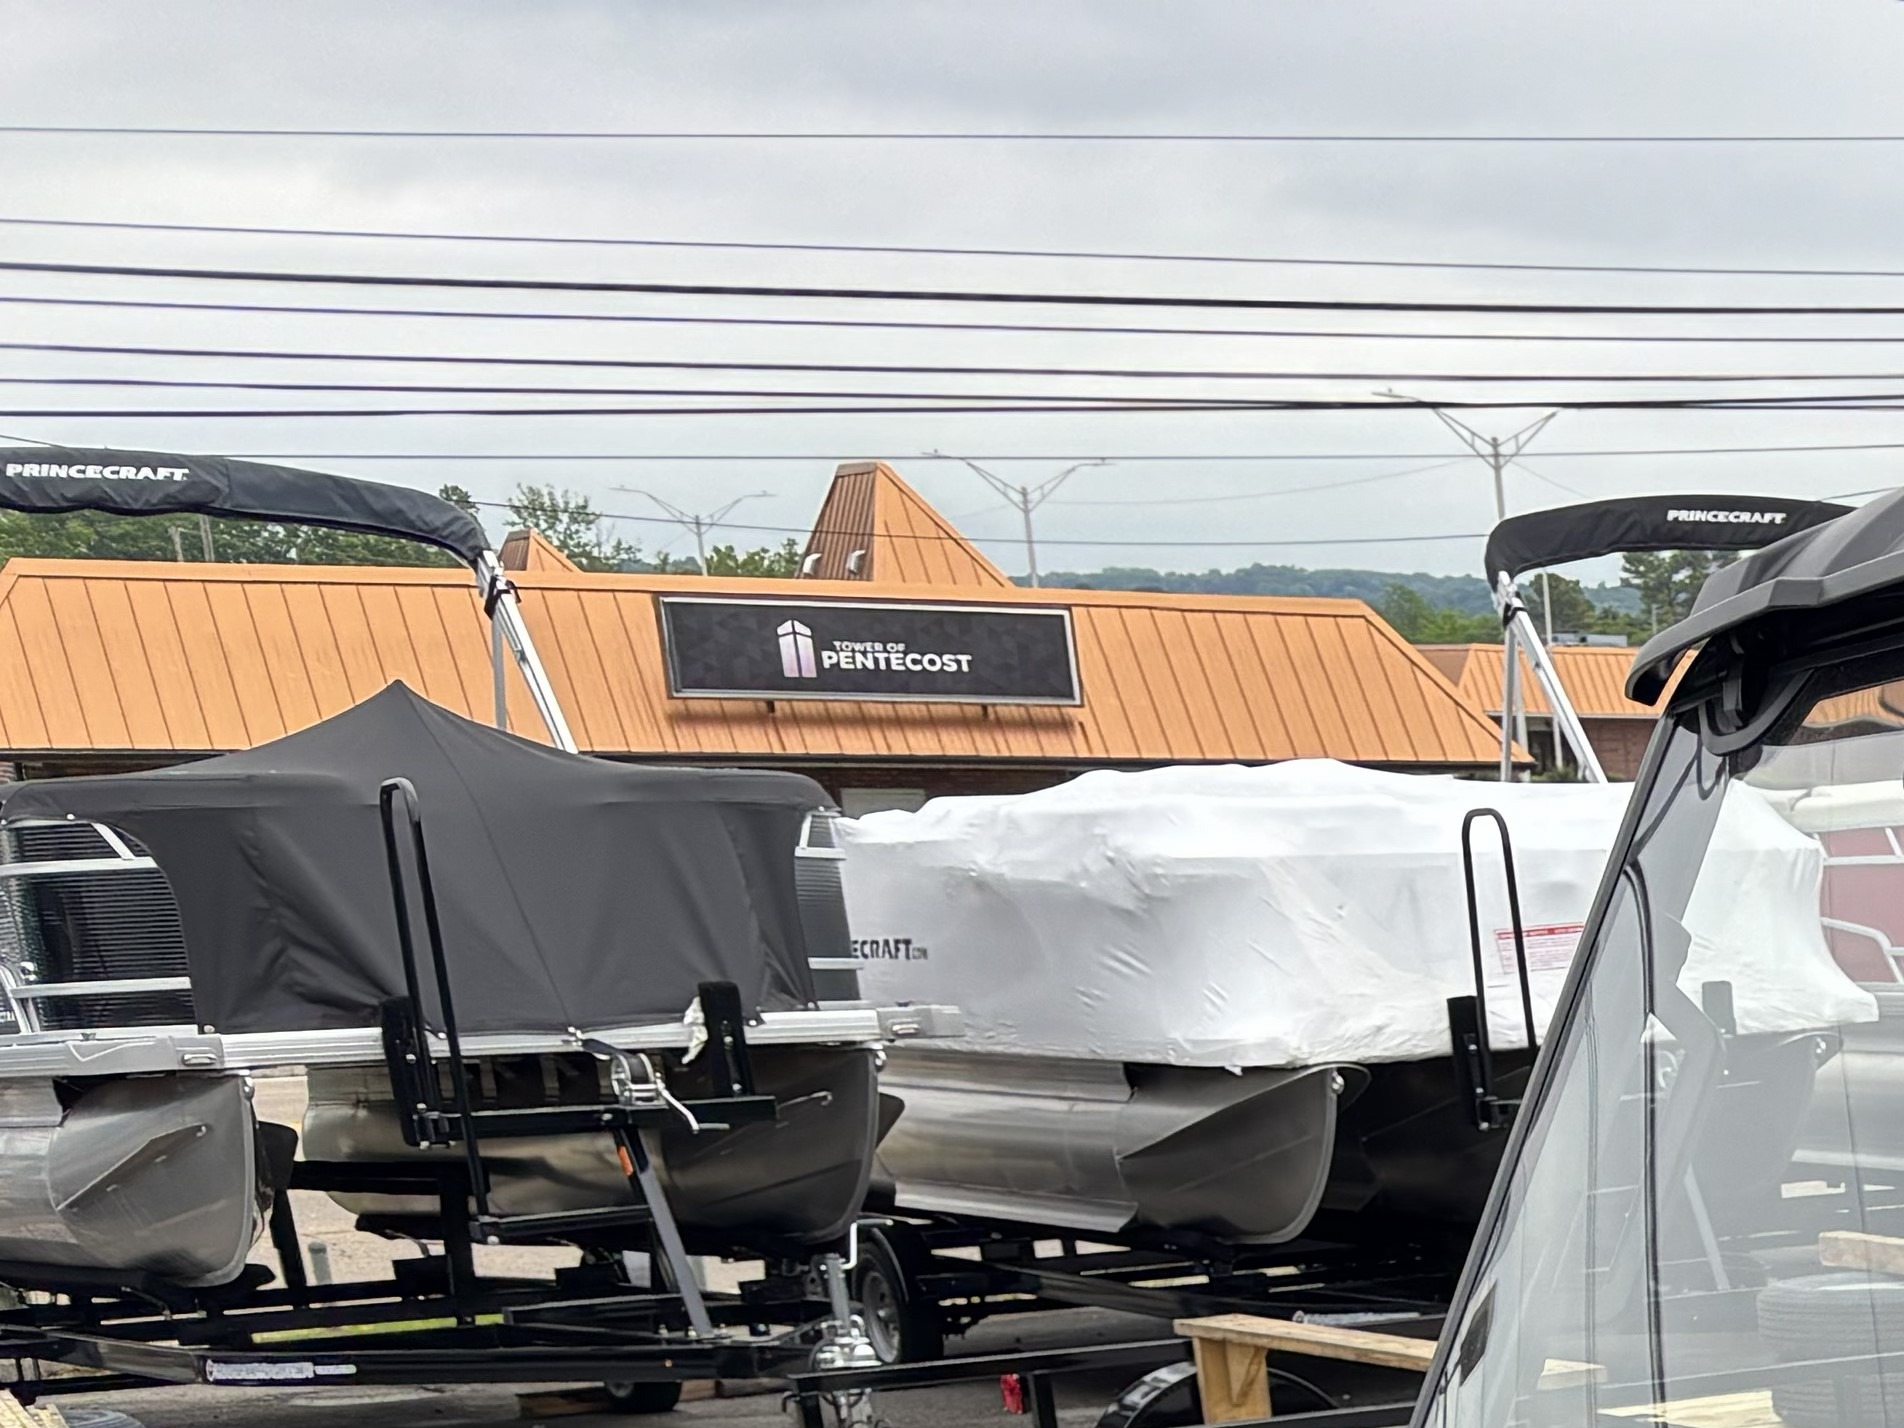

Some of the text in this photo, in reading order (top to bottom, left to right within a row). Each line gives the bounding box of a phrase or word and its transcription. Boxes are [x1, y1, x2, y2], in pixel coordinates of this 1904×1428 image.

[5, 462, 191, 482] PRINCECRAFT
[1665, 508, 1788, 525] PRINCECRAFT
[832, 640, 906, 653] TOWER OF
[820, 650, 973, 673] PENTECOST
